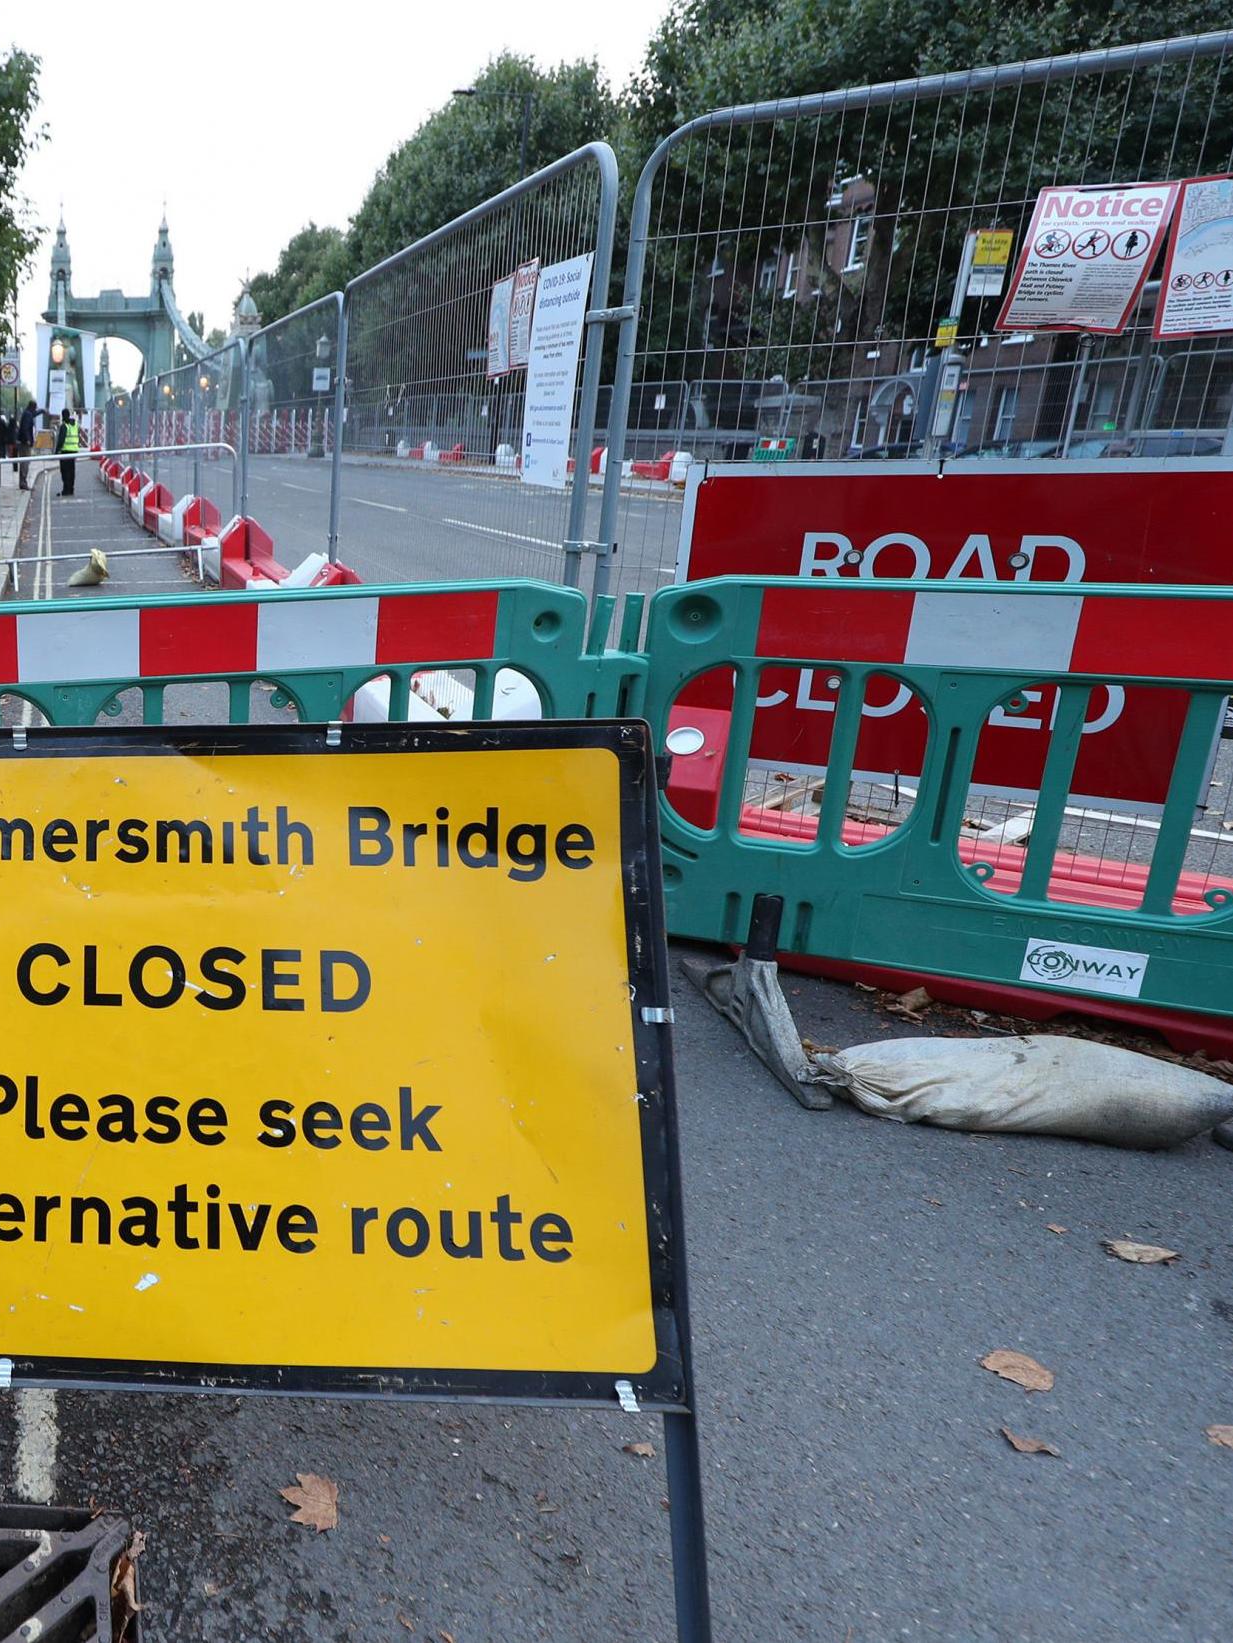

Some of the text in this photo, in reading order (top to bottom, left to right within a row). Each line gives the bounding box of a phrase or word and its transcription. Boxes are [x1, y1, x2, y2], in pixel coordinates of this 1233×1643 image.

[1043, 191, 1164, 219] Notice
[799, 532, 1087, 582] ROAD
[349, 807, 596, 882] Bridge
[17, 943, 371, 1012] CLOSED
[1026, 950, 1141, 981] CONWAY
[258, 1087, 443, 1152] seek
[352, 1195, 573, 1263] route
